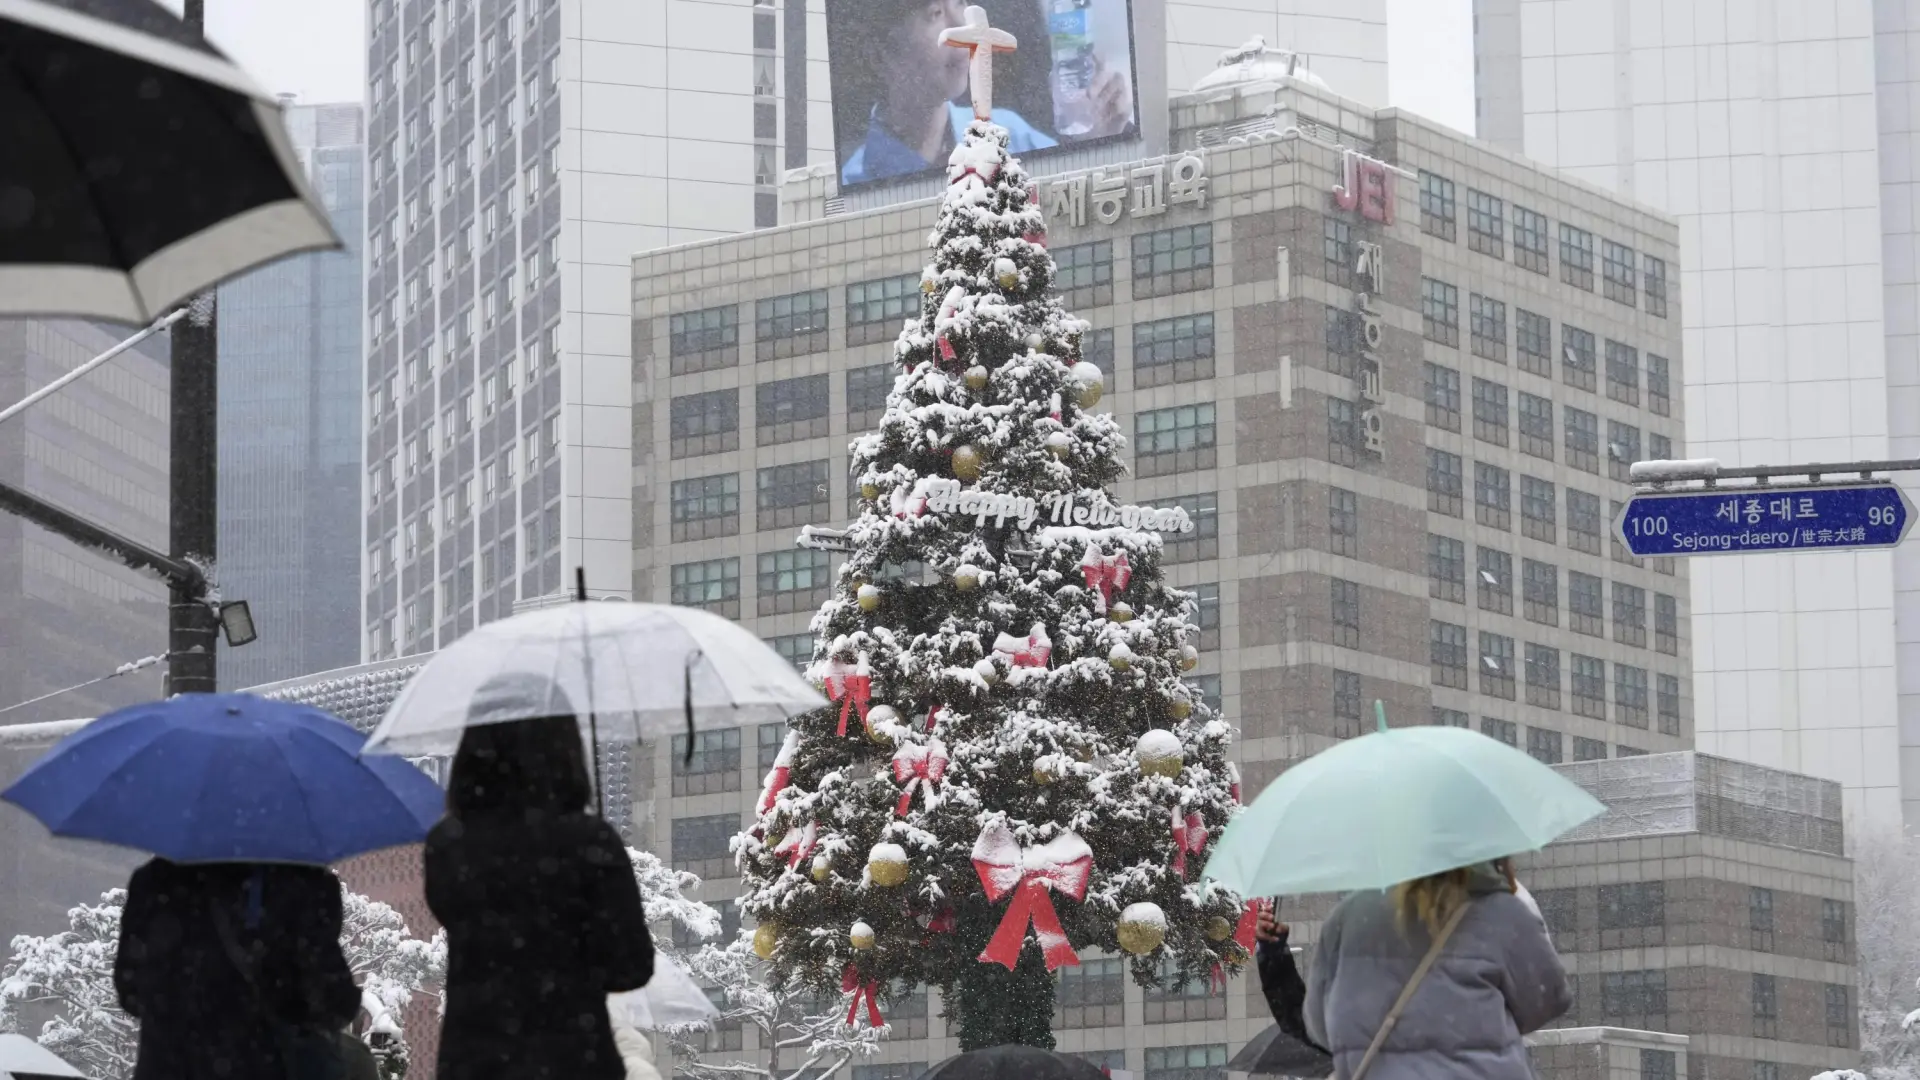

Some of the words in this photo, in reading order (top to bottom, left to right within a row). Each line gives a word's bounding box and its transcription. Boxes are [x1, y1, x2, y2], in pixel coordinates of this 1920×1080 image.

[1050, 154, 1208, 227] 재능교육
[1332, 149, 1396, 226] JEI
[1356, 241, 1385, 463] 재능교육
[926, 478, 1039, 531] Happy
[1047, 489, 1120, 526] New
[1631, 516, 1668, 537] 100
[1716, 497, 1819, 524] 세종대로
[1868, 506, 1896, 526] 96
